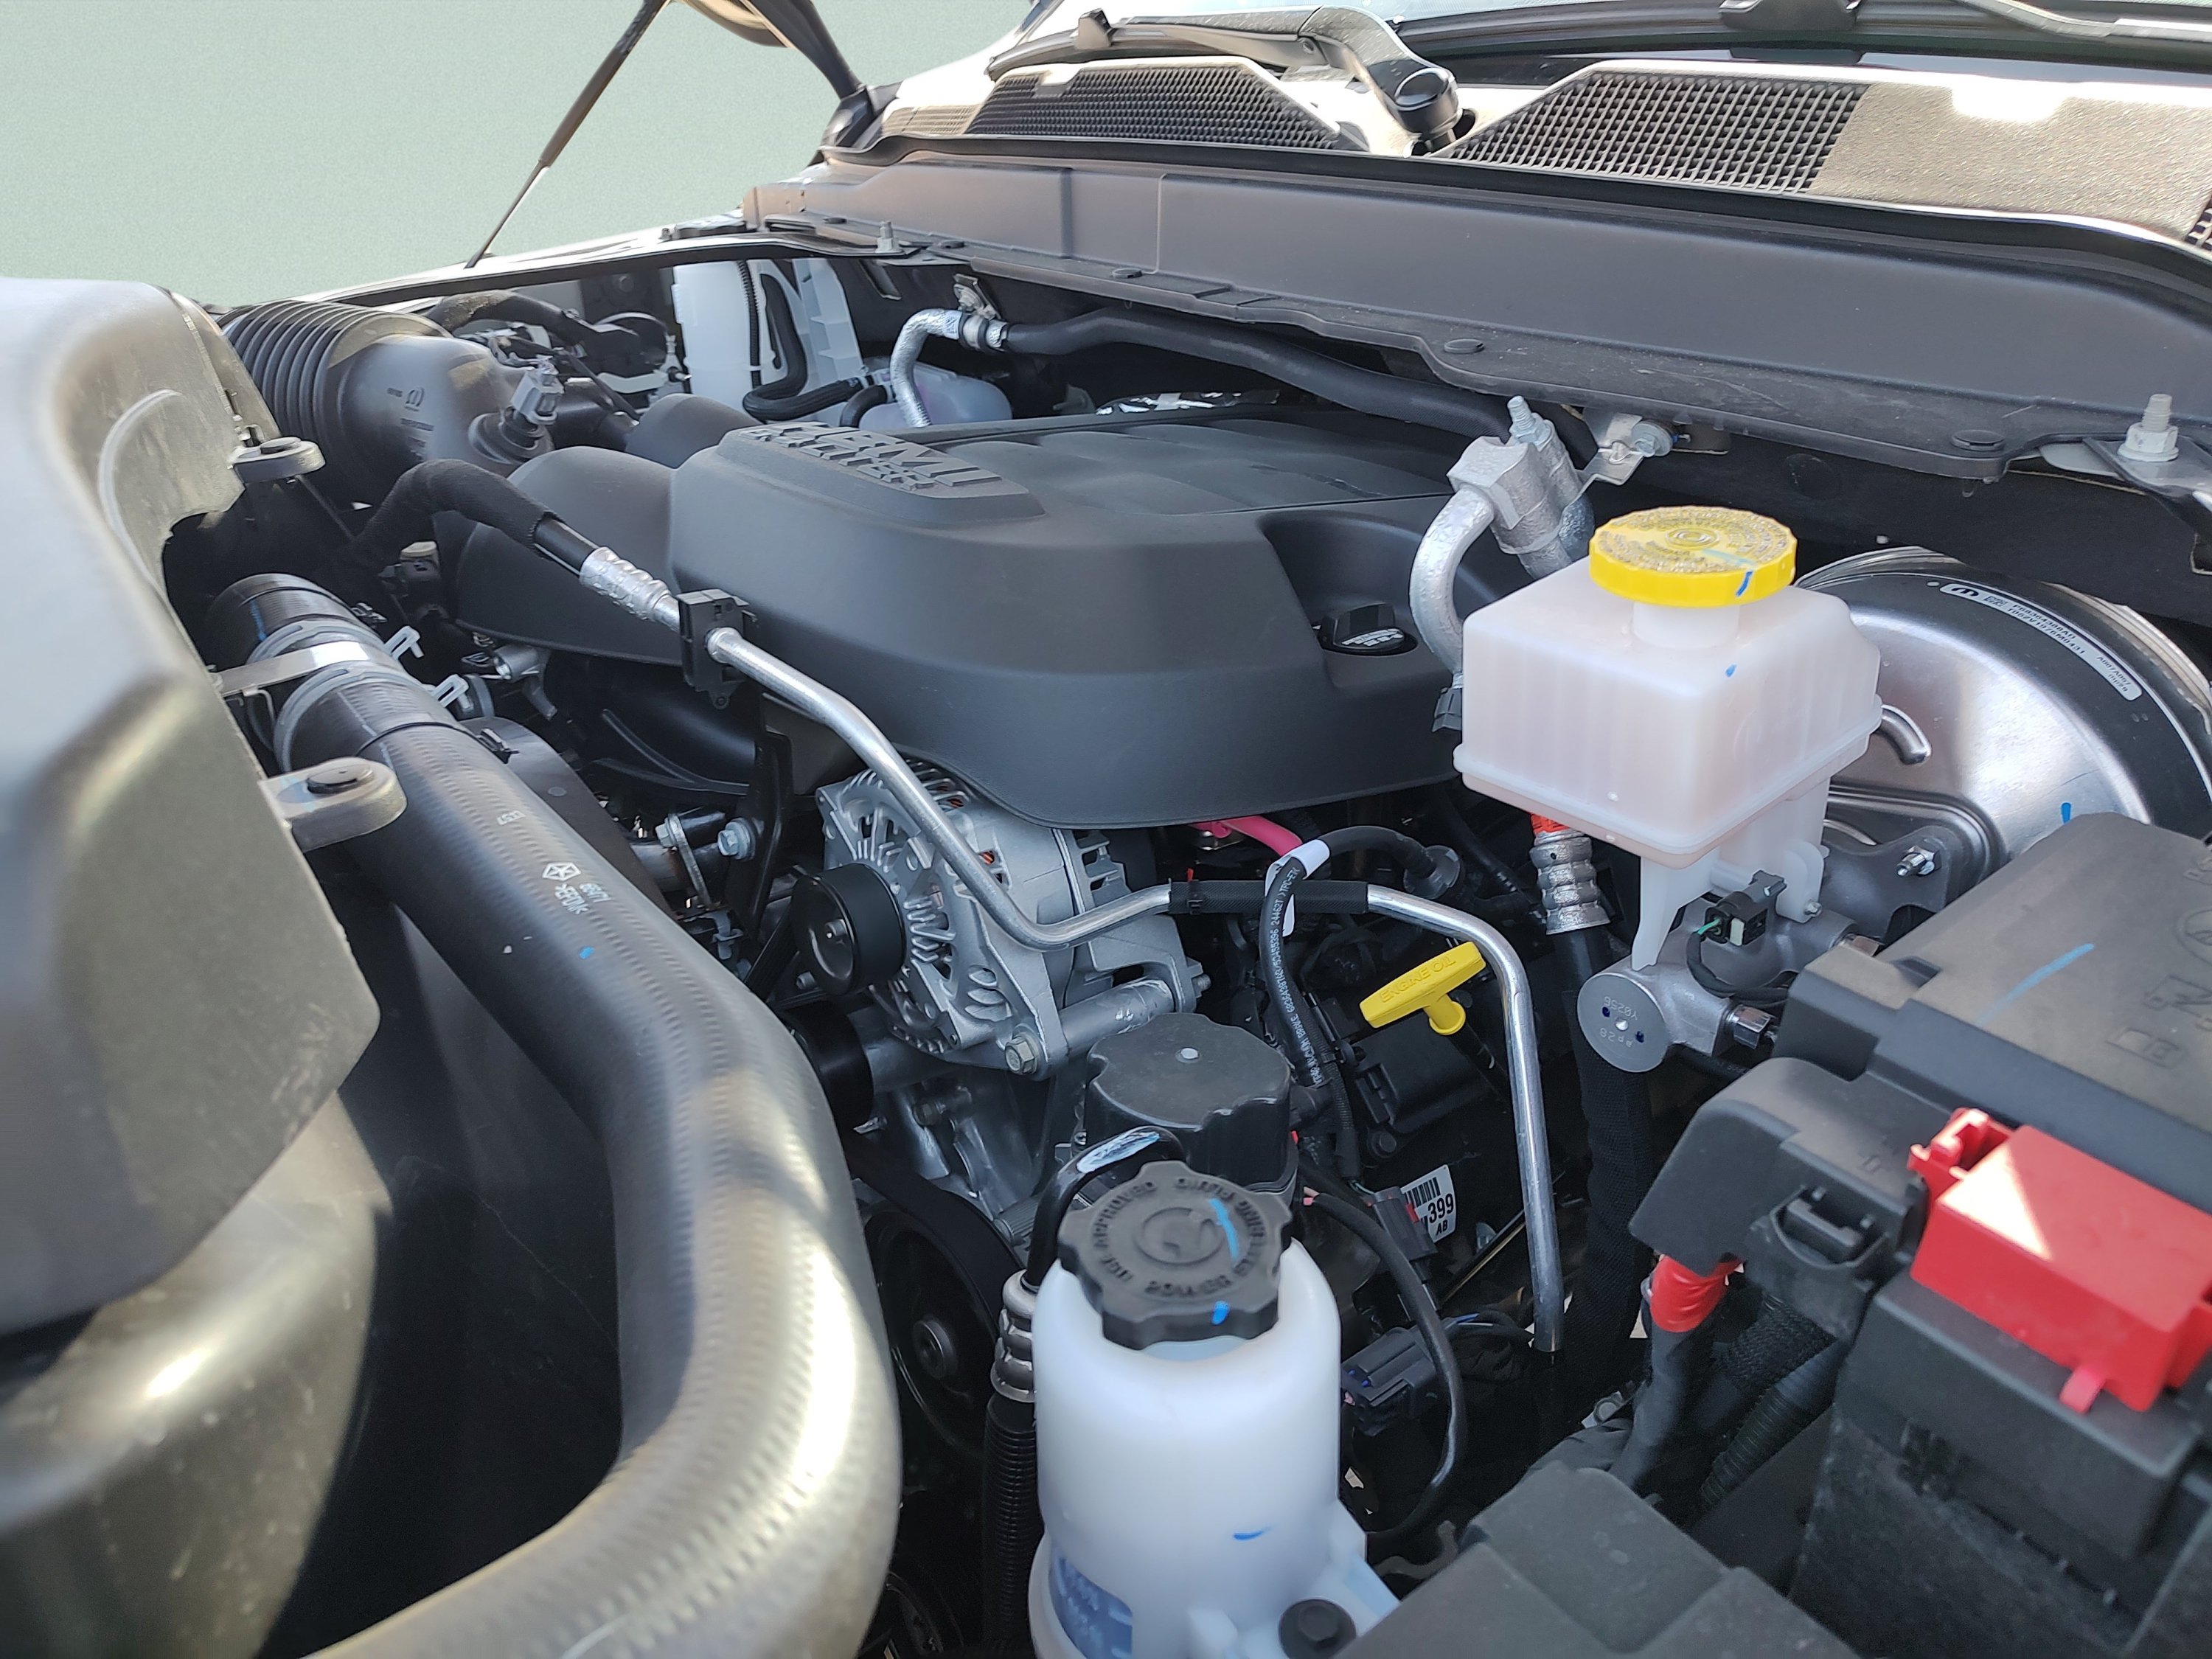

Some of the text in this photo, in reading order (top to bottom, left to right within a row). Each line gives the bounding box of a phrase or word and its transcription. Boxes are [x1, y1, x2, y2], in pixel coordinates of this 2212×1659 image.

[1380, 956, 1456, 1003] ENGINE OIL
[1290, 1013, 1307, 1038] BRAKE
[1092, 1180, 1158, 1249] APPROVED
[1427, 1193, 1454, 1224] 399
[1436, 1220, 1448, 1237] AB
